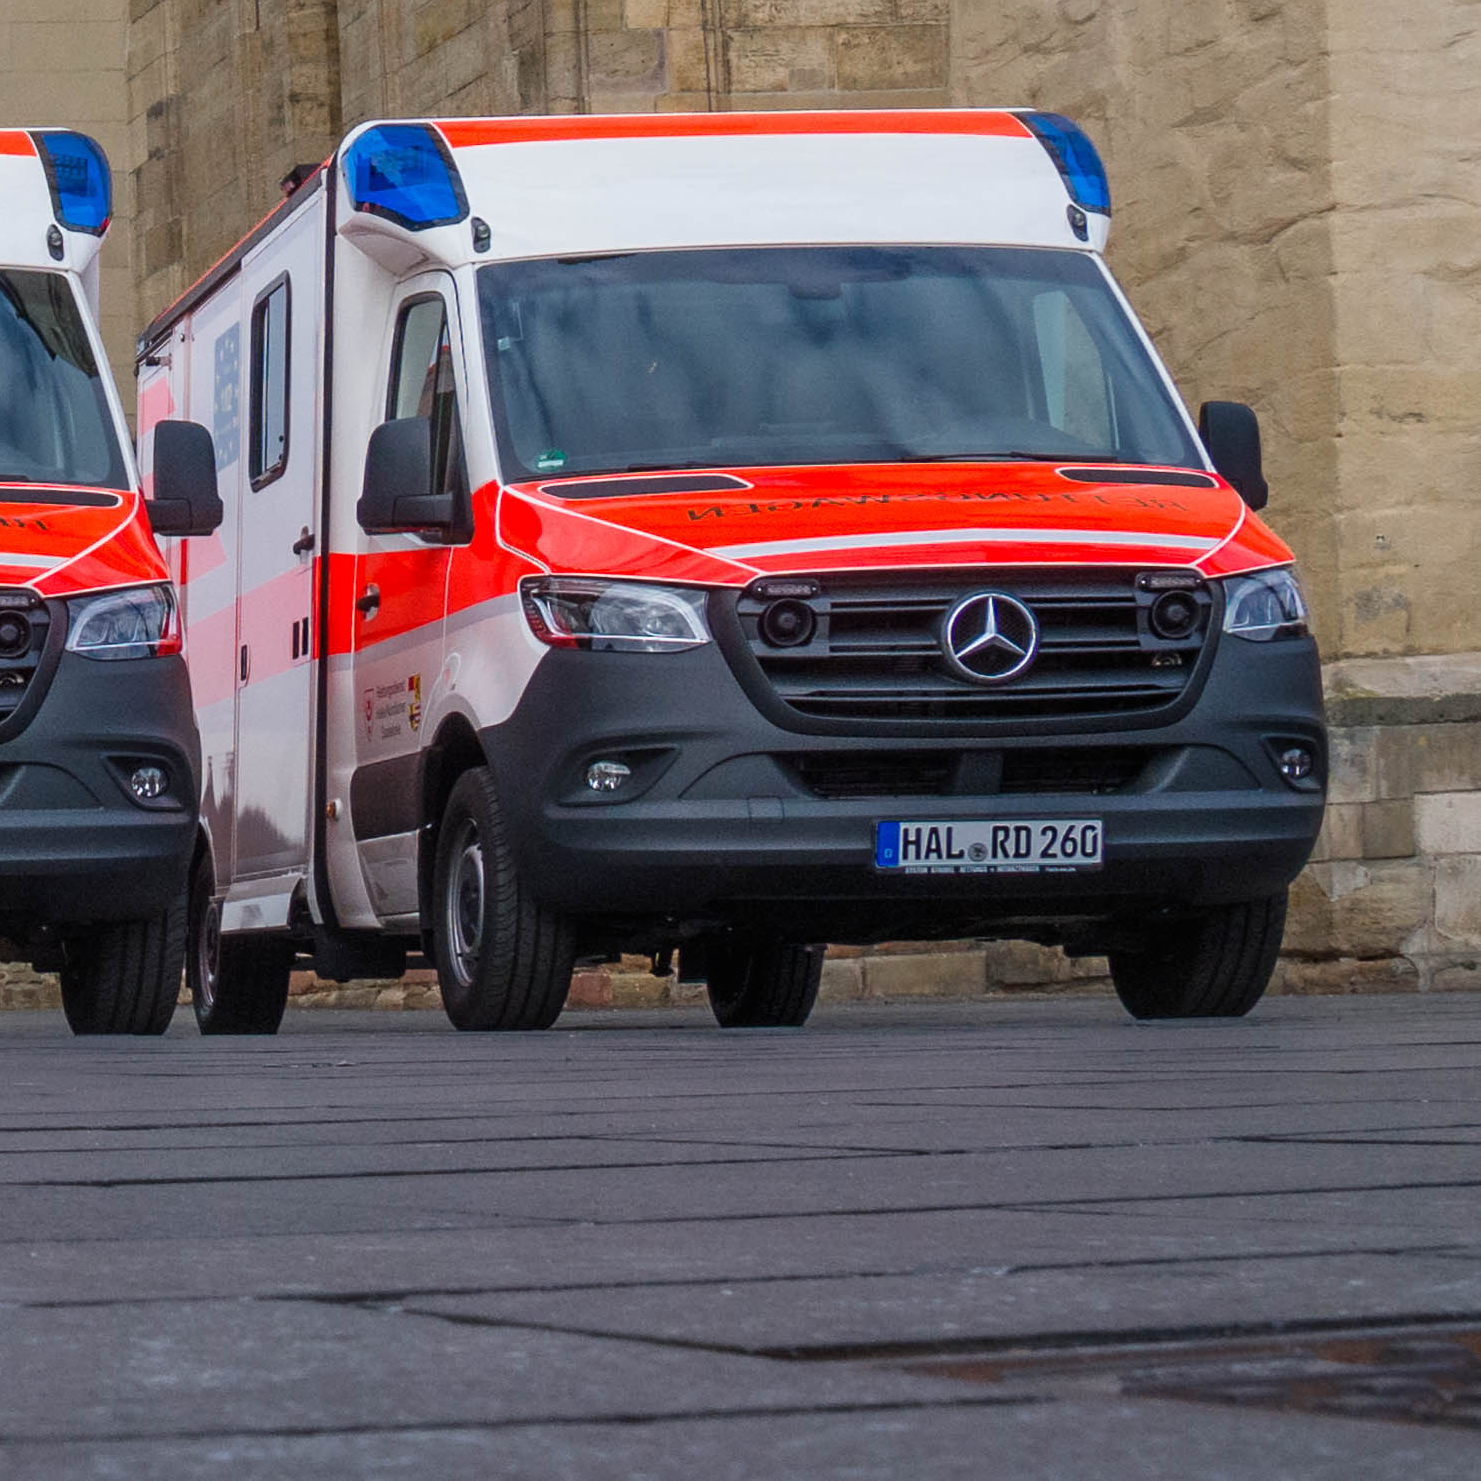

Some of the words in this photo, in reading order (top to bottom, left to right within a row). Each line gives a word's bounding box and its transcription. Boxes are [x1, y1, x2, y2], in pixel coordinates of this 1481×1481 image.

[902, 827, 965, 860] HAL
[992, 825, 1032, 859] RD
[1040, 825, 1098, 859] 260
